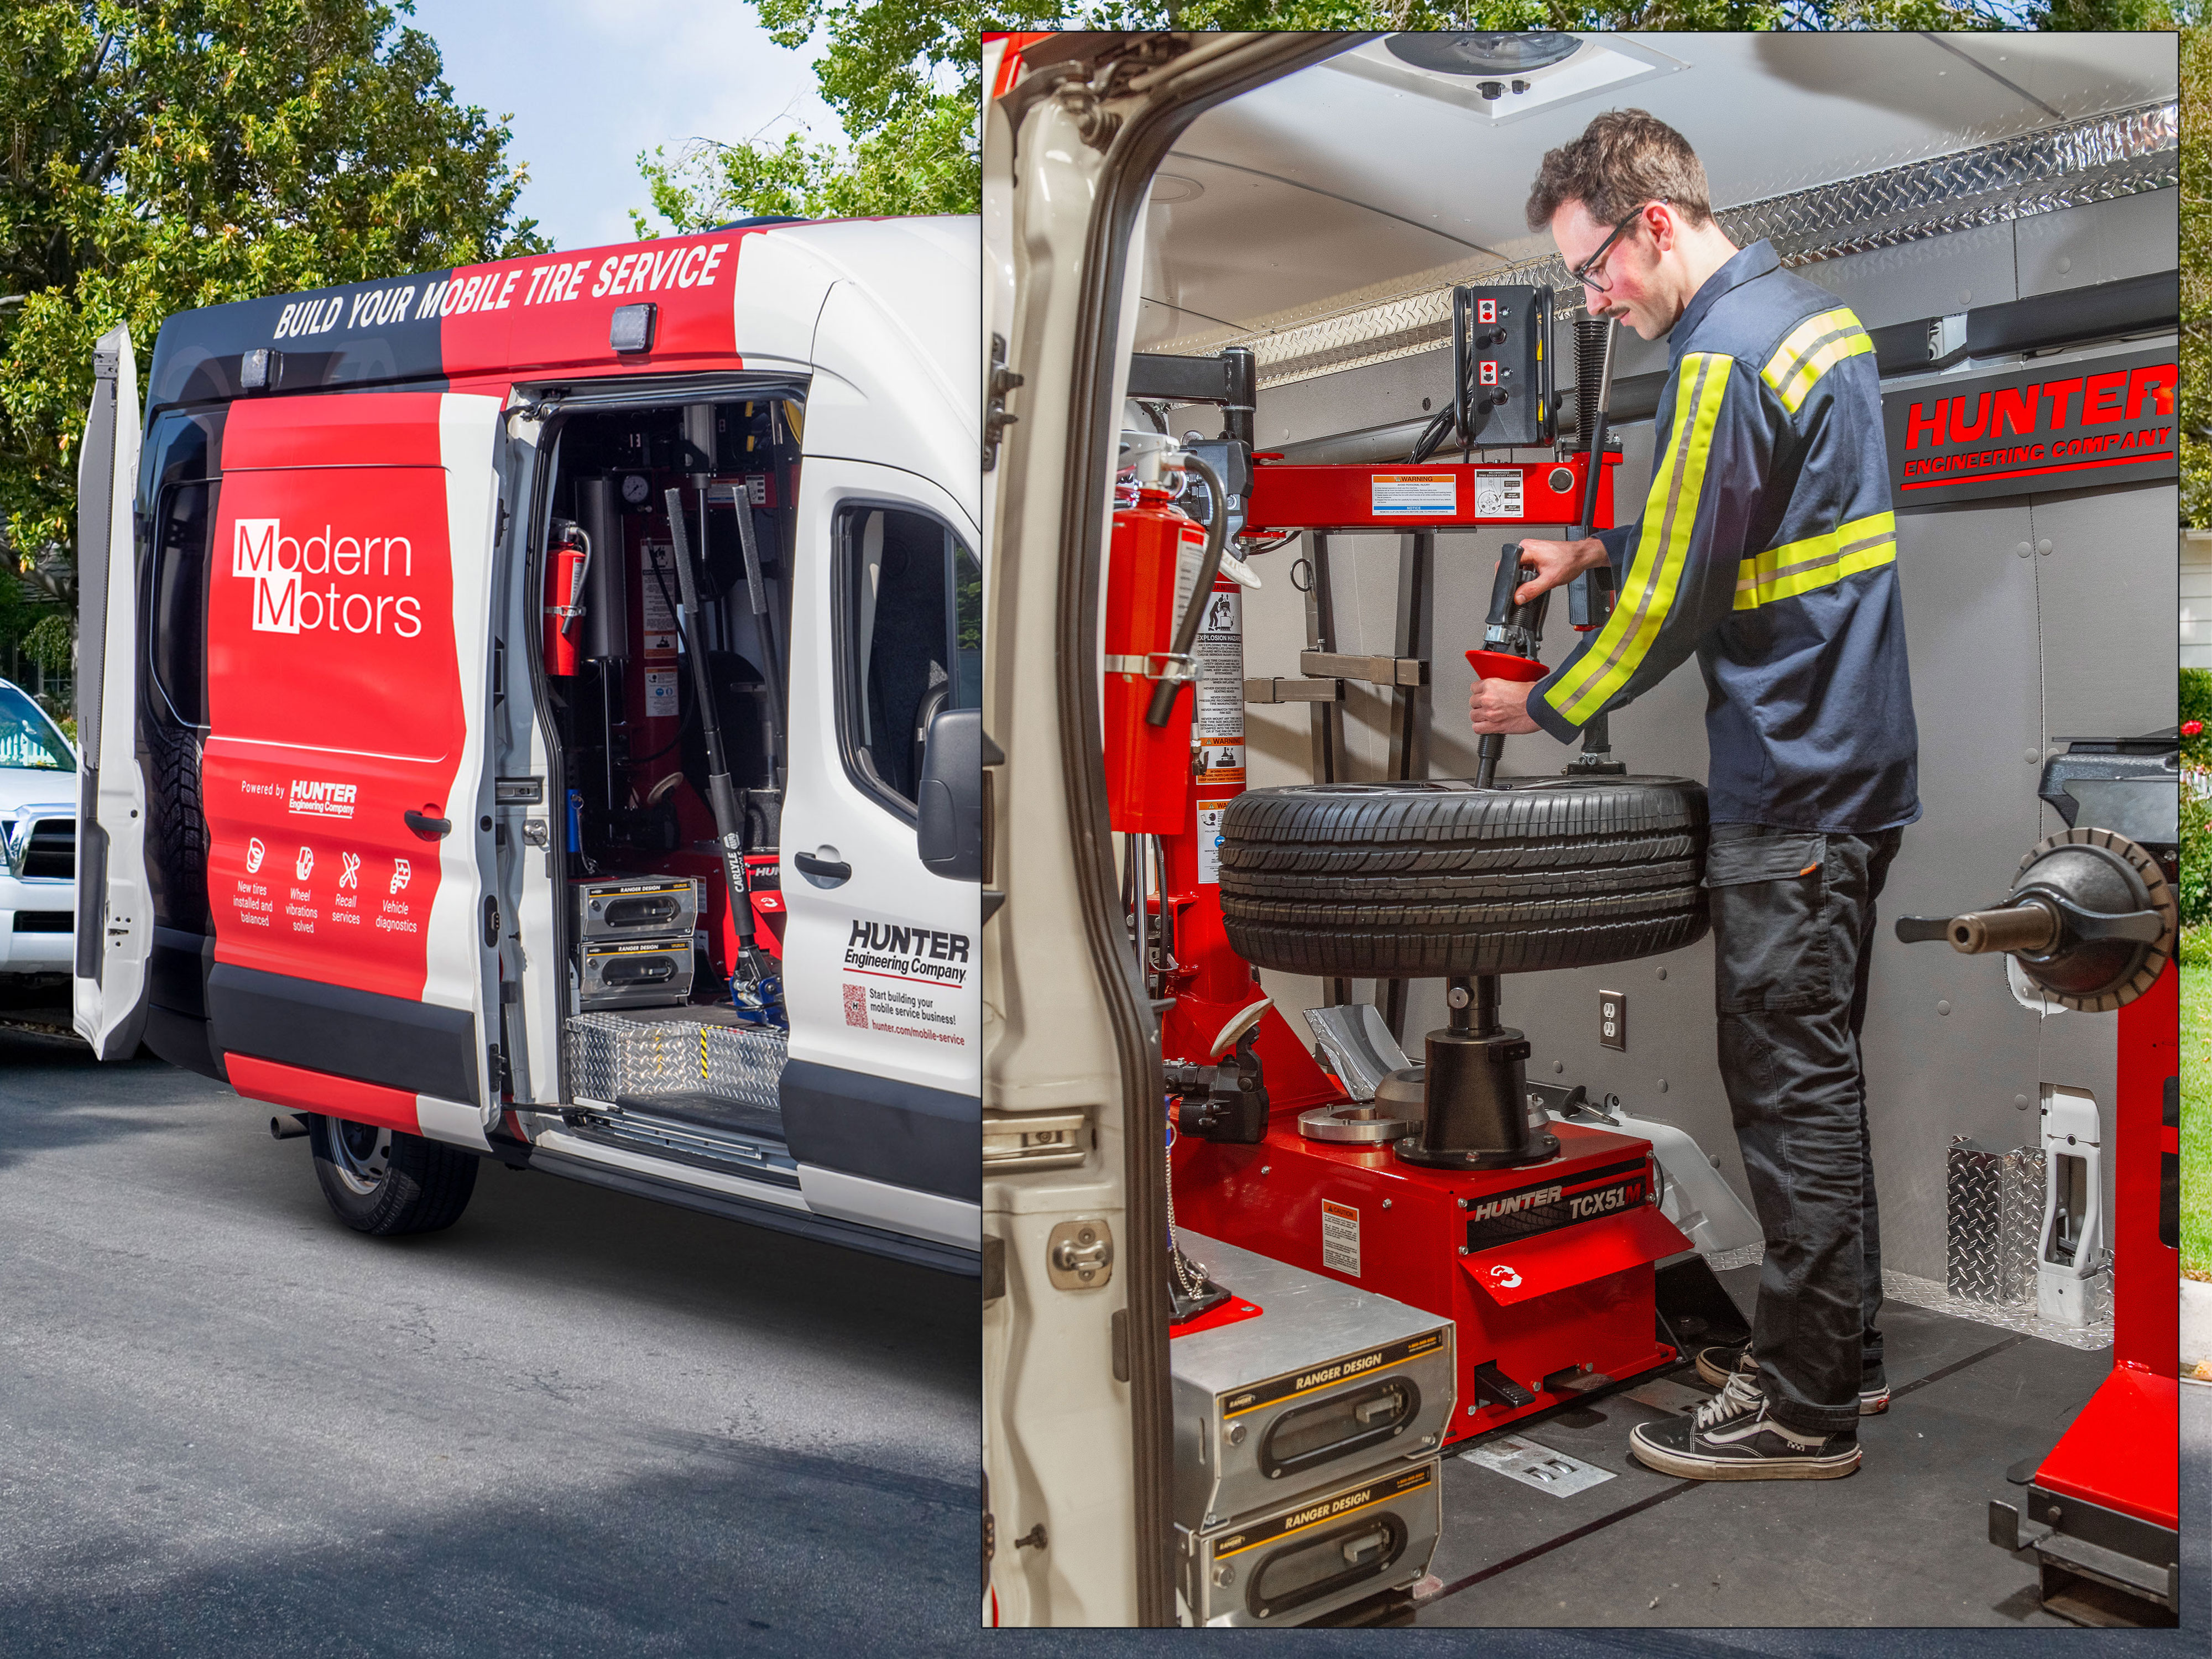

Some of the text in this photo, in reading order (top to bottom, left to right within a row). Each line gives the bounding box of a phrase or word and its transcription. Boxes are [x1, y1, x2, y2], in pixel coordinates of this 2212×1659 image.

[273, 243, 729, 340] BUILD YOUR MOBILE TIRE SERVICE
[1905, 363, 2178, 450] HUNTER
[1904, 427, 2172, 477] ENGINEERING COMPANY
[237, 524, 412, 576] Modern
[257, 577, 422, 638] Motors
[241, 780, 285, 799] Powered by
[290, 780, 357, 804] HUNTER
[289, 799, 324, 812] Engineering
[727, 852, 744, 893] CARLYLE
[237, 880, 267, 896] New tires
[290, 888, 311, 901] Wheel
[233, 895, 273, 912] installed and
[285, 903, 318, 919] vibrations
[335, 894, 357, 907] Recall
[383, 899, 409, 915] Vehicle
[241, 911, 269, 926] balanced
[293, 920, 314, 933] solved
[332, 911, 361, 925] services
[375, 915, 418, 933] diagnostics
[848, 919, 970, 963] HUNTER
[844, 948, 966, 983] Engineering Company
[869, 988, 933, 1009] Start building your
[870, 1003, 956, 1025] mobile service business!
[872, 1019, 965, 1046] hunter.com/mobile-service
[1333, 1207, 1353, 1218] CAUTION
[1474, 1183, 1641, 1222] HUNTER TCX51M
[1296, 1353, 1383, 1390] RANGER DESIGN
[1285, 1490, 1371, 1530] RANGER DESIGN
